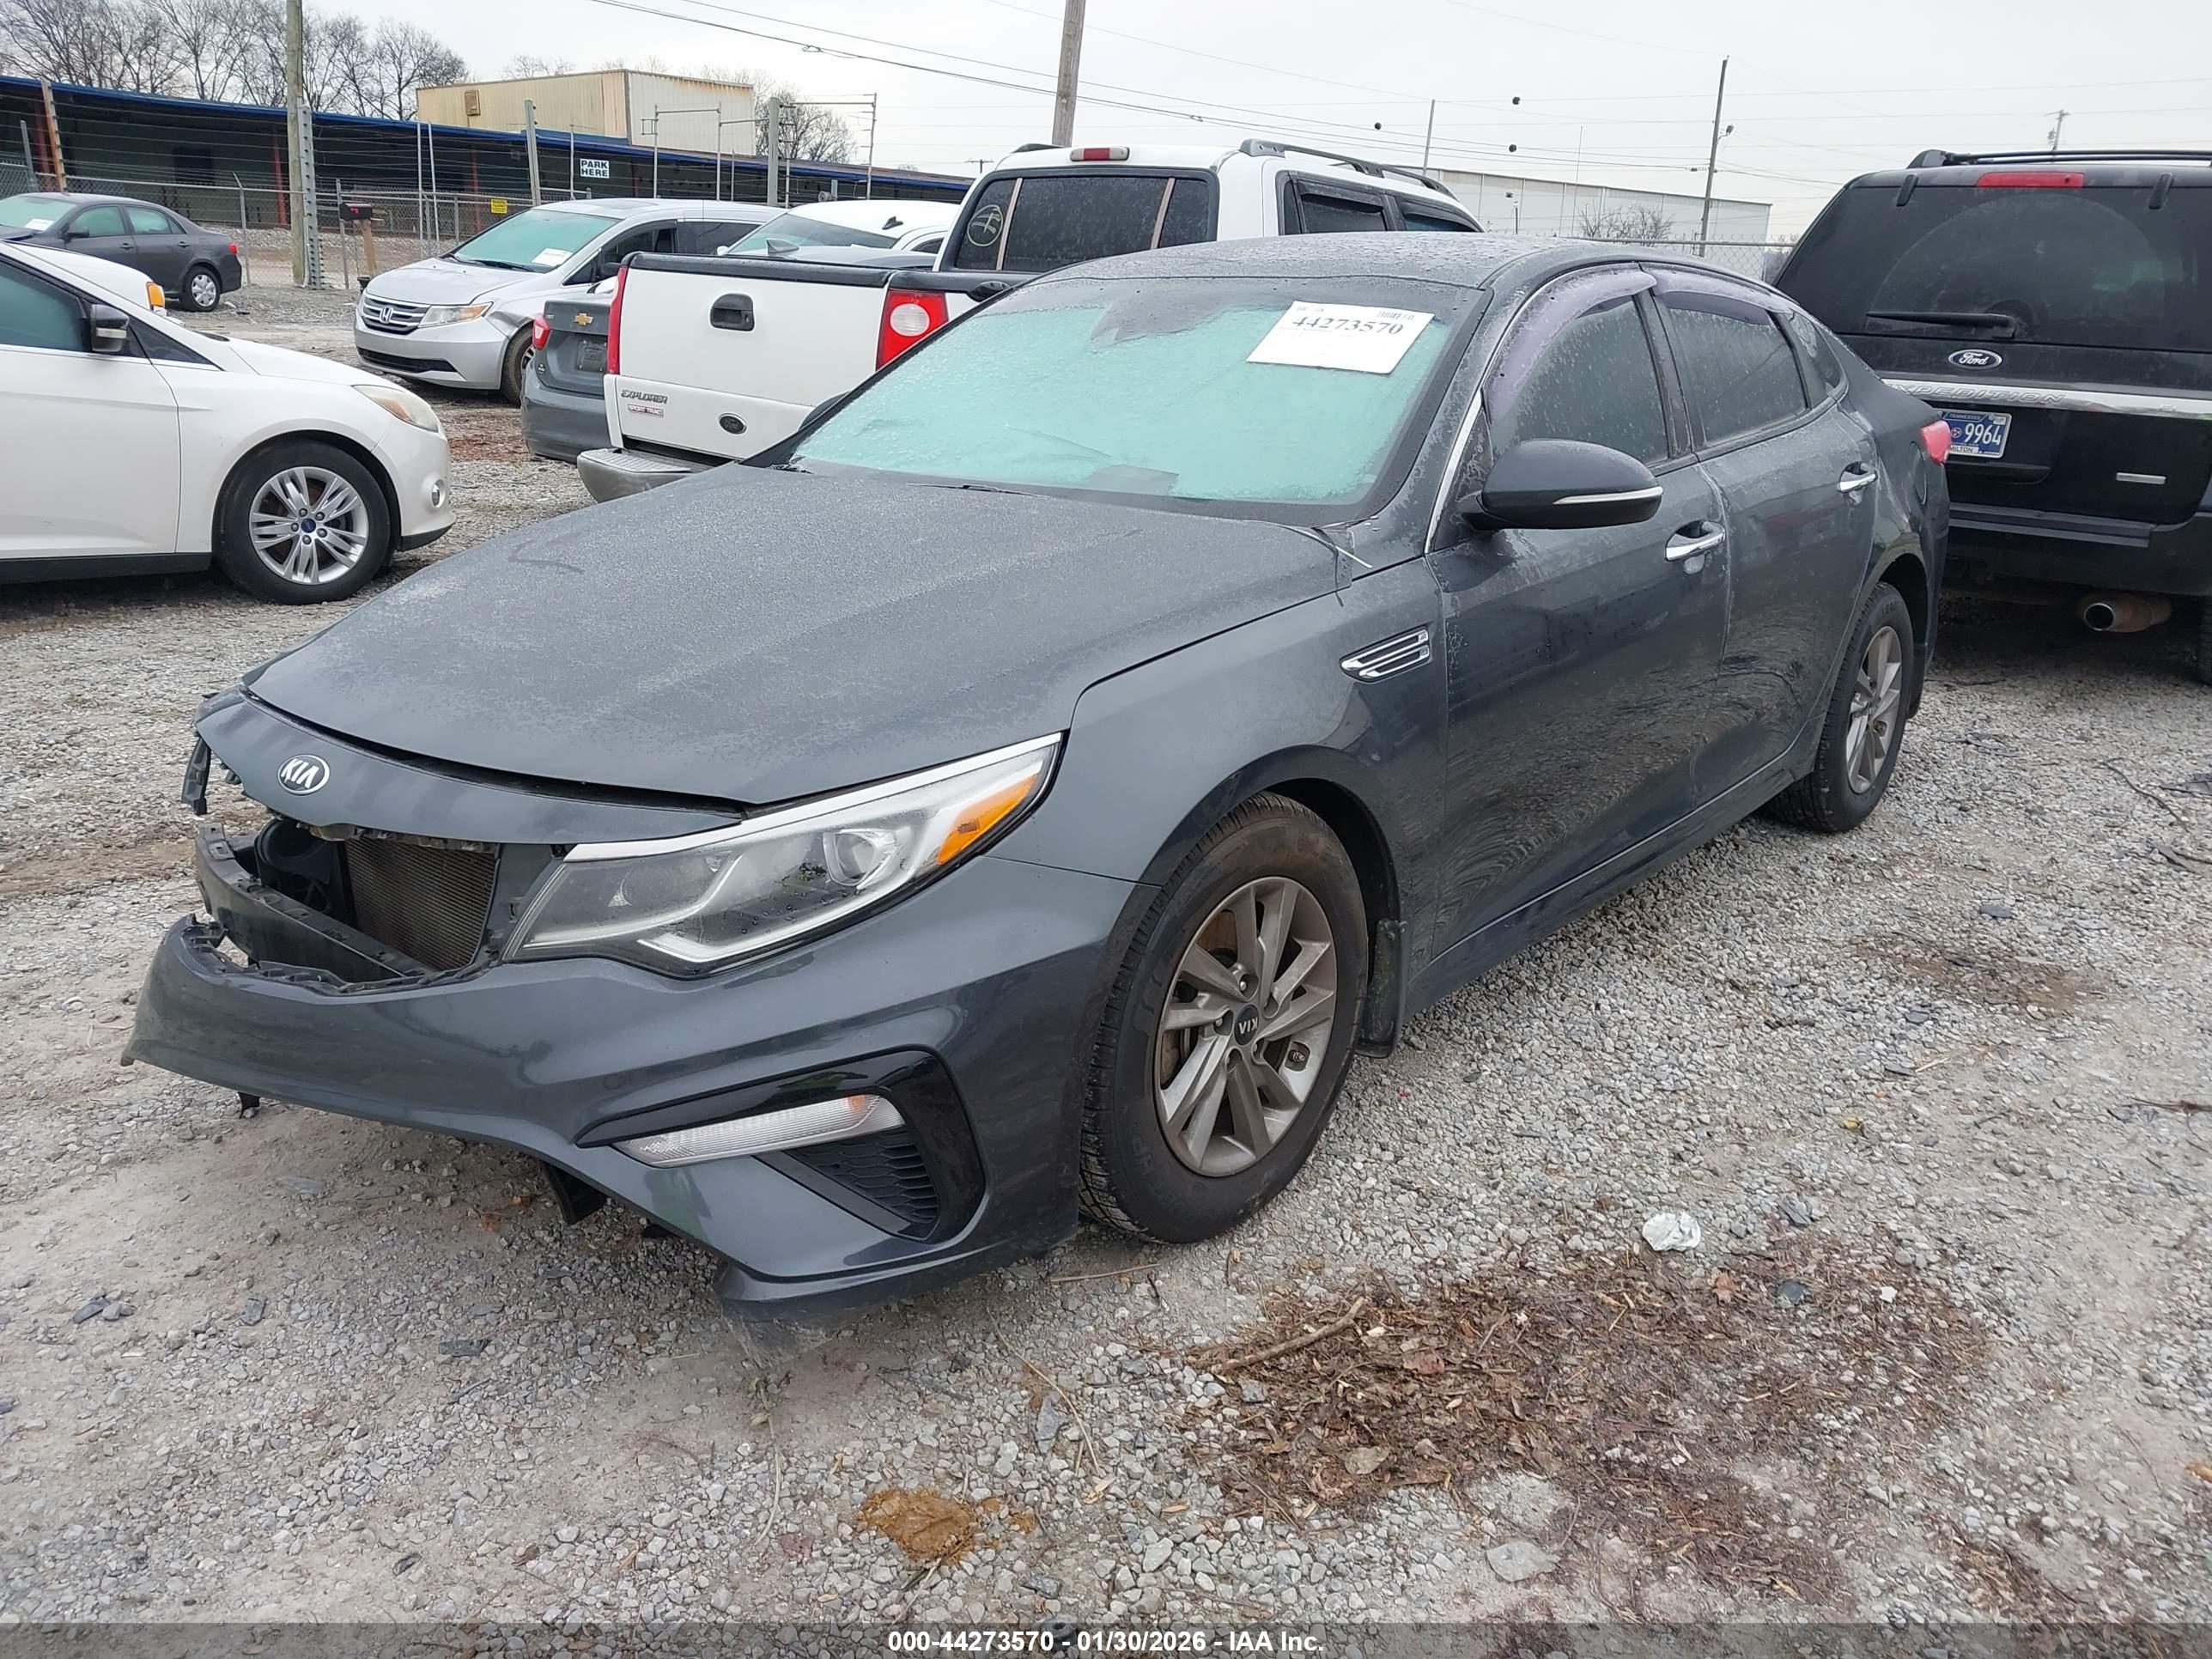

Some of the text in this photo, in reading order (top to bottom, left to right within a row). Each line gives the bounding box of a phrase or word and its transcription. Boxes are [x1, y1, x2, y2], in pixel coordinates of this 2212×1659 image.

[581, 160, 607, 169] PARK
[581, 168, 608, 177] HERE
[1292, 316, 1404, 335] 44273570
[1959, 352, 1990, 365] Ford
[621, 389, 668, 404] EXPLORER
[1892, 384, 2066, 403] XPEDITION
[1964, 422, 2002, 446] 9964
[280, 757, 320, 789] KIA
[1238, 1017, 1259, 1035] KIA
